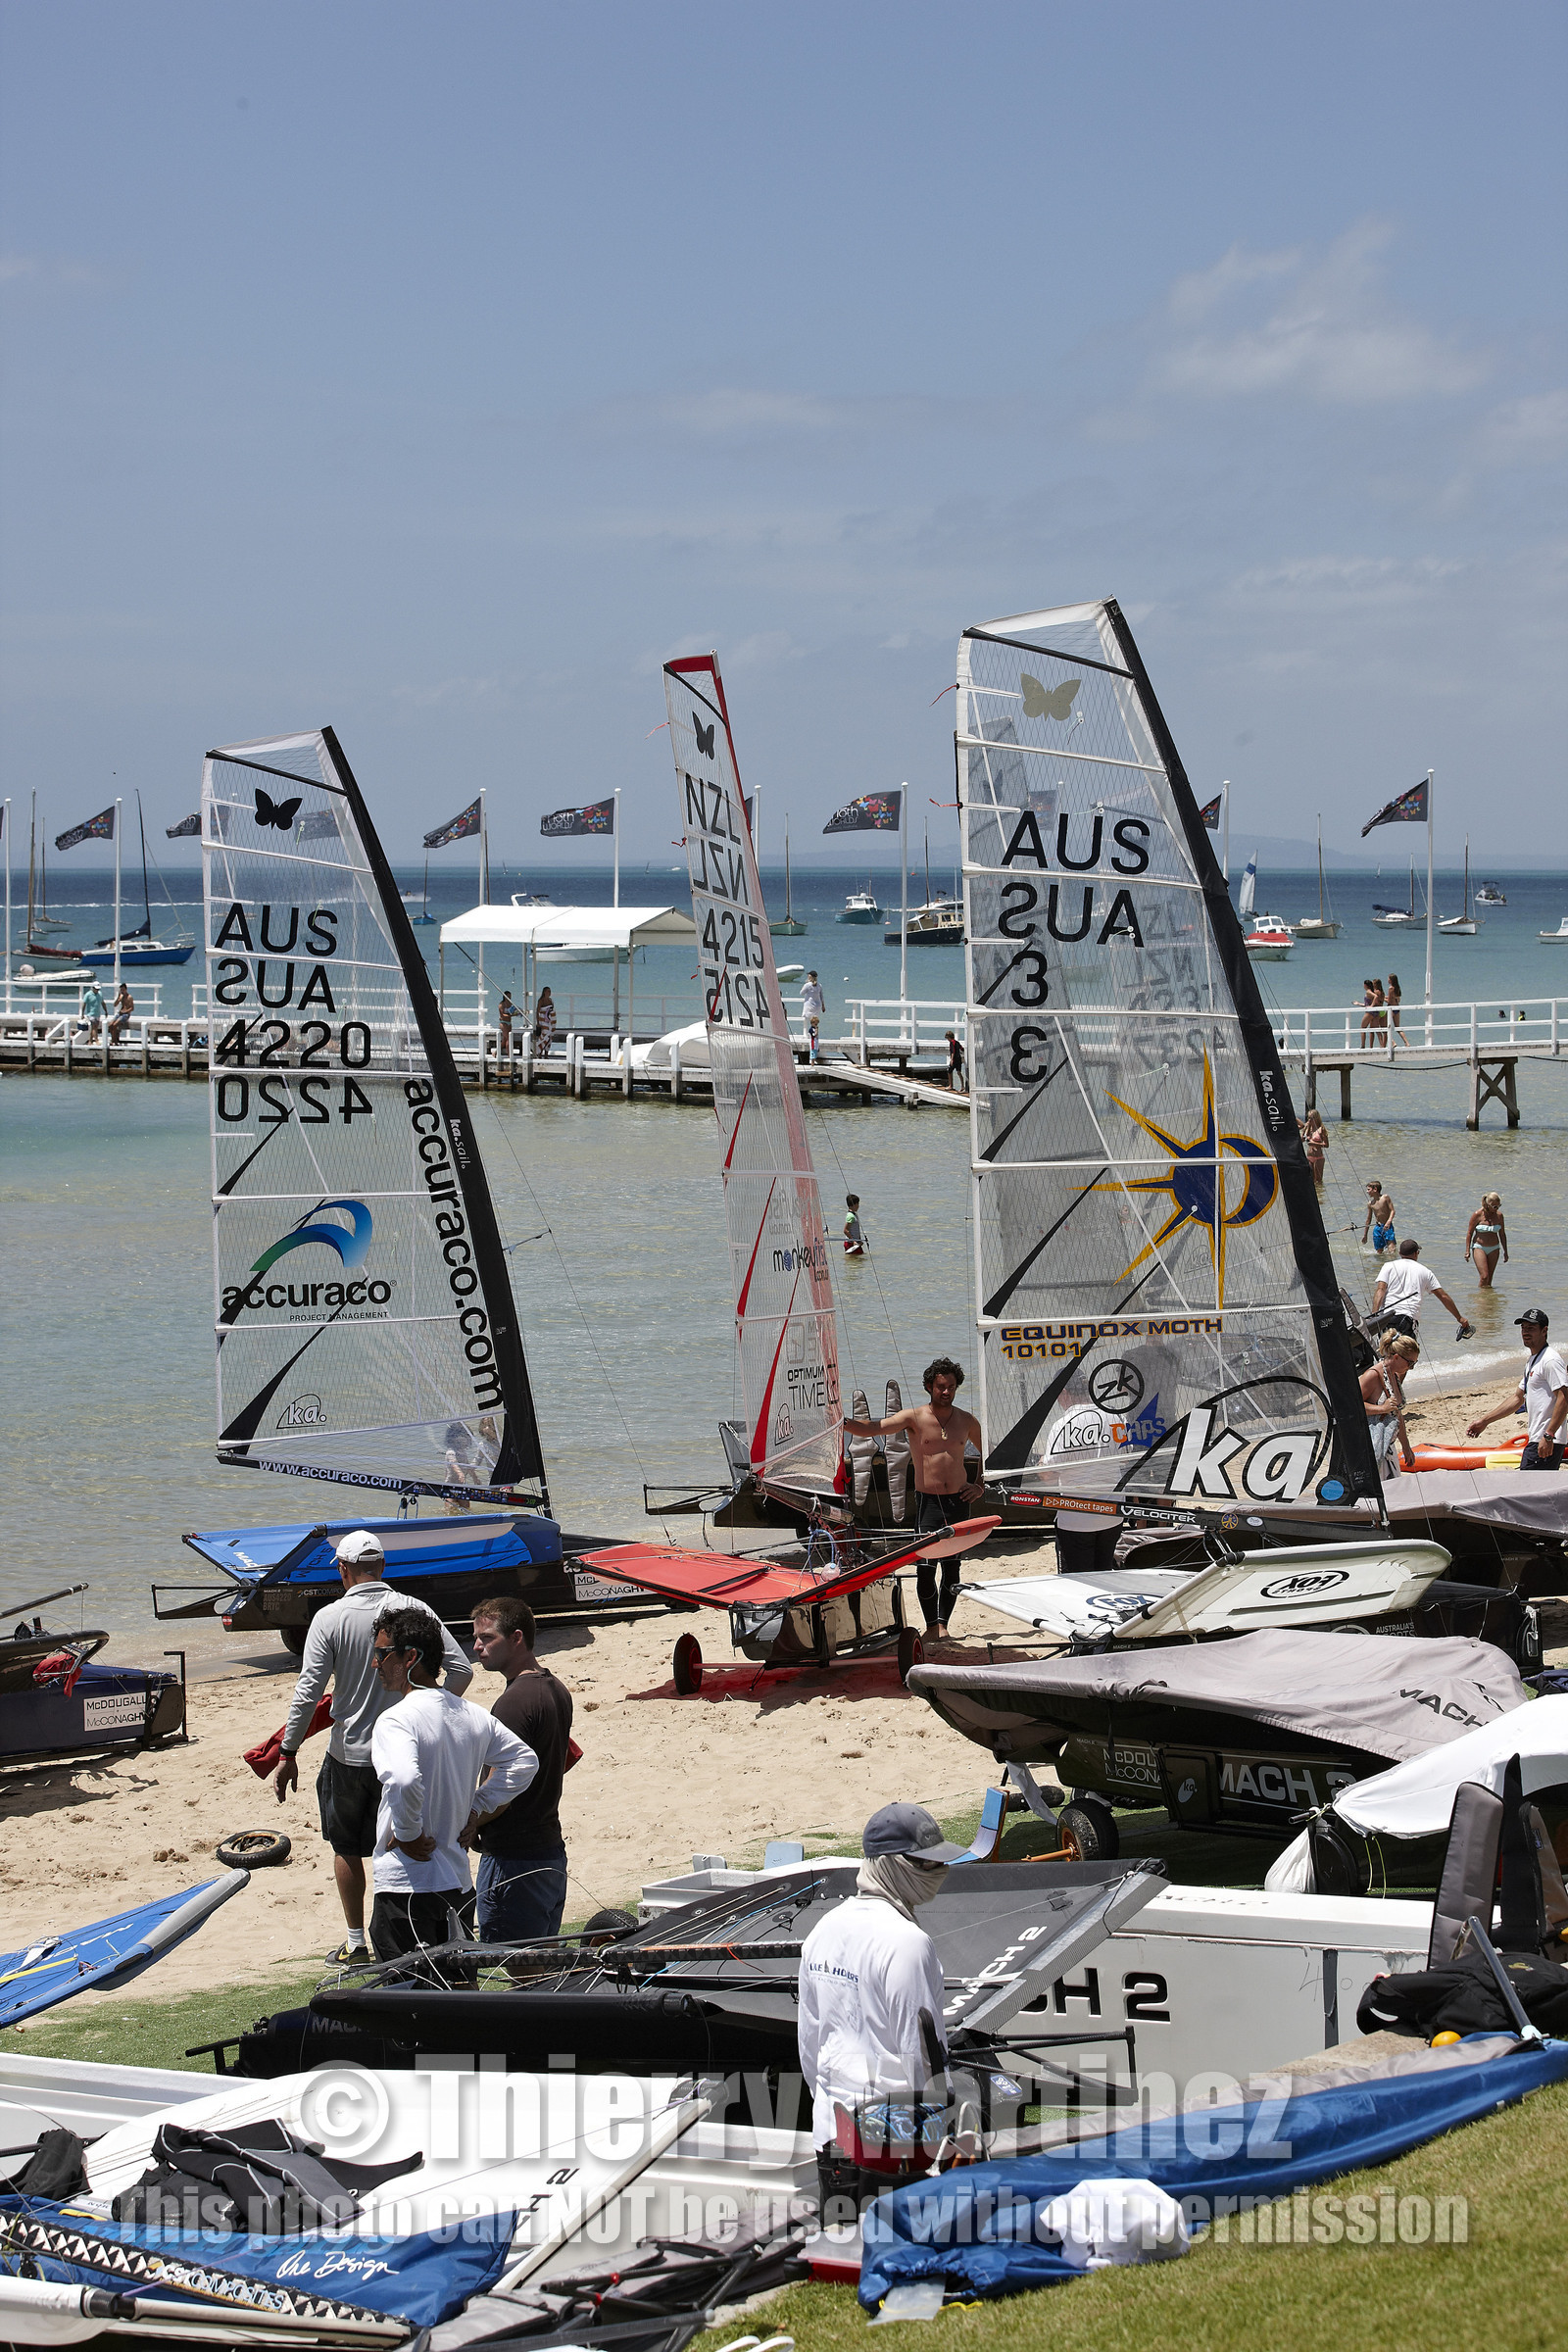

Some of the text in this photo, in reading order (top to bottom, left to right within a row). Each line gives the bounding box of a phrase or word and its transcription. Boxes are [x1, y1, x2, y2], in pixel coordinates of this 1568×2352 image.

[685, 772, 742, 846] NZL
[1001, 810, 1151, 875] AUS
[214, 902, 338, 957] AUS
[702, 907, 765, 969] 4215
[1011, 950, 1049, 1007] 3
[216, 1019, 371, 1069] 4220
[403, 1078, 505, 1411] accuraco.com
[289, 1311, 389, 1322] PROJECT MANAGEMENT
[1001, 1317, 1223, 1342] EQUINOX MOTH
[1002, 1342, 1082, 1360] 10101
[788, 1366, 825, 1383] OPTIMUM
[788, 1382, 826, 1411] TIME
[259, 1460, 403, 1490] www.accuraco.com
[1059, 1498, 1114, 1514] PROtect tapes
[1120, 1505, 1197, 1524] VELOCITEK
[1375, 1621, 1415, 1635] AUSTRALIA'S
[1219, 1762, 1320, 1806] MACH
[1122, 1972, 1171, 2025] 2
[276, 2249, 400, 2280] One Design
